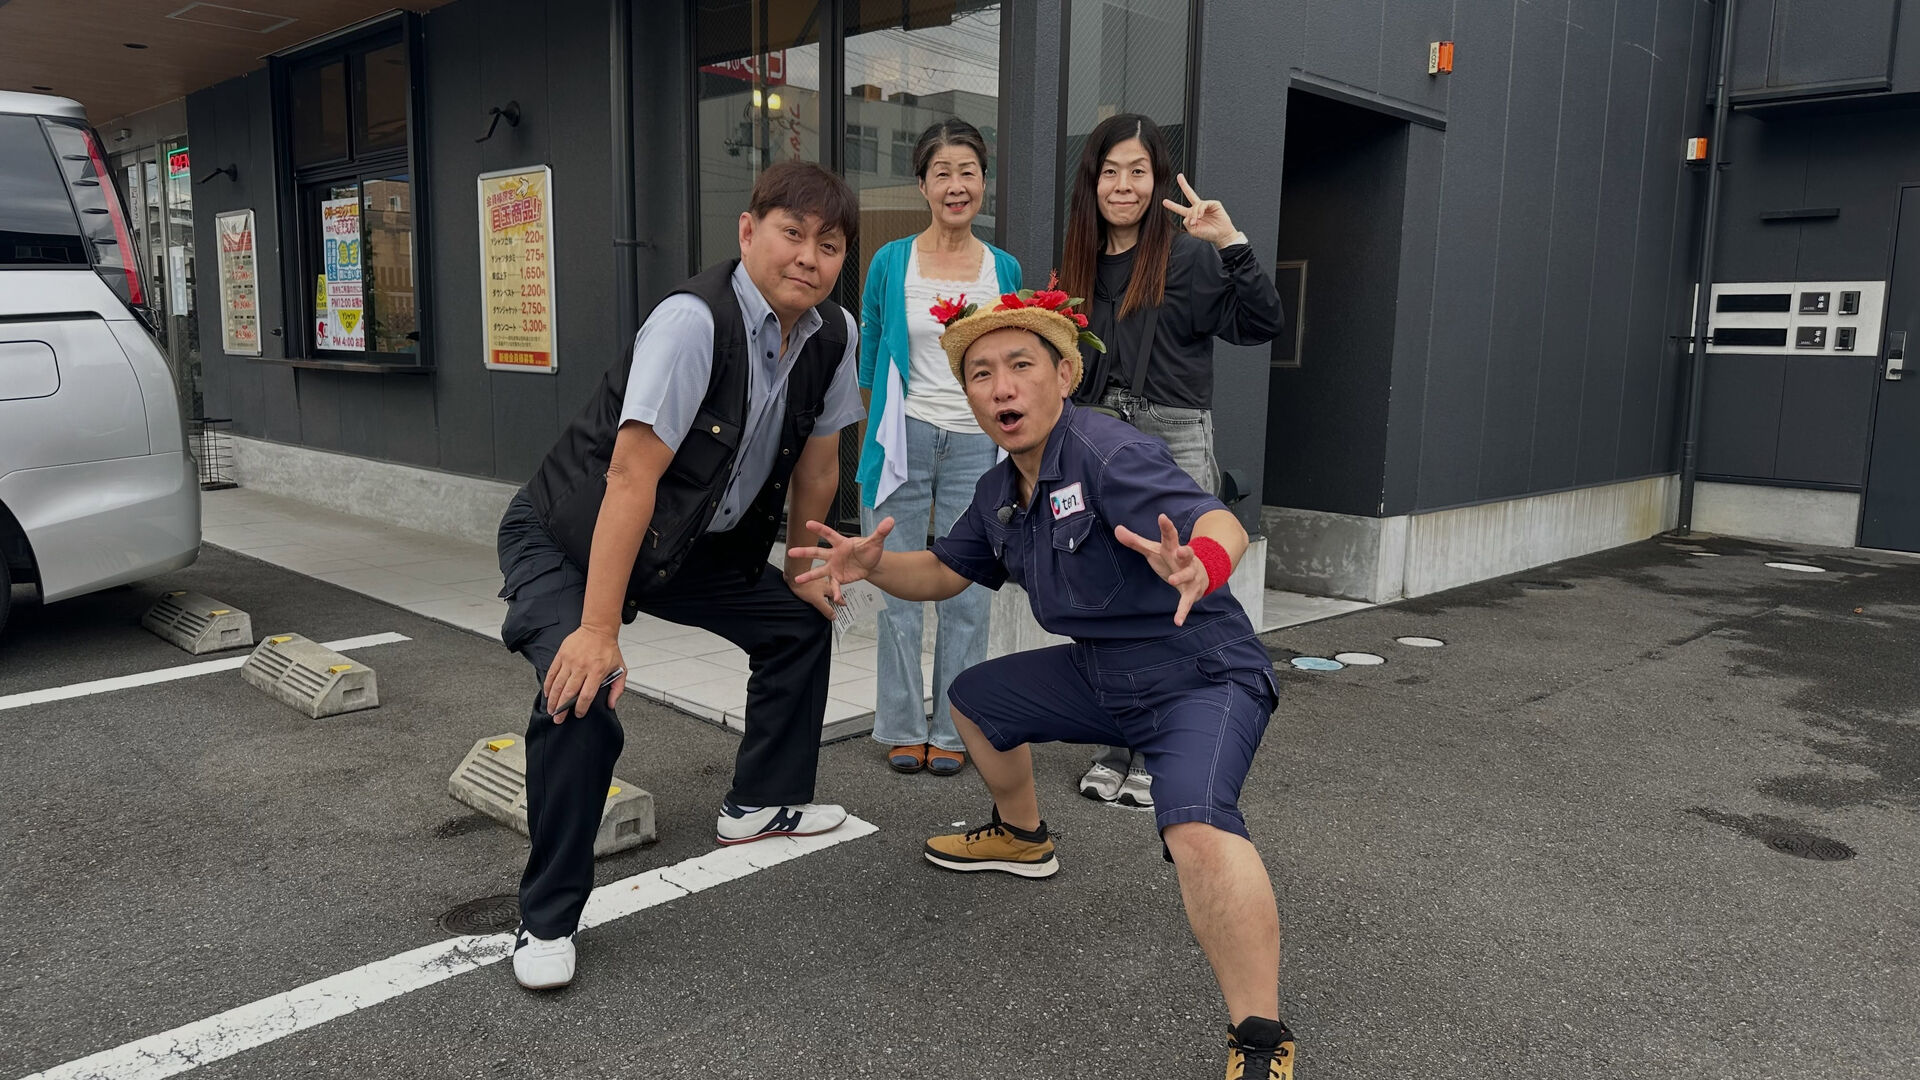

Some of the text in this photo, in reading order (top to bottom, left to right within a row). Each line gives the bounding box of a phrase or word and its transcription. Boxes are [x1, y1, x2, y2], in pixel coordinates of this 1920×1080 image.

[525, 230, 544, 244] 220円
[525, 249, 545, 262] 275円
[520, 266, 545, 280] 1,650円
[521, 284, 546, 298] 2,200円
[521, 302, 547, 316] 2,750円
[522, 319, 548, 333] 3,300円
